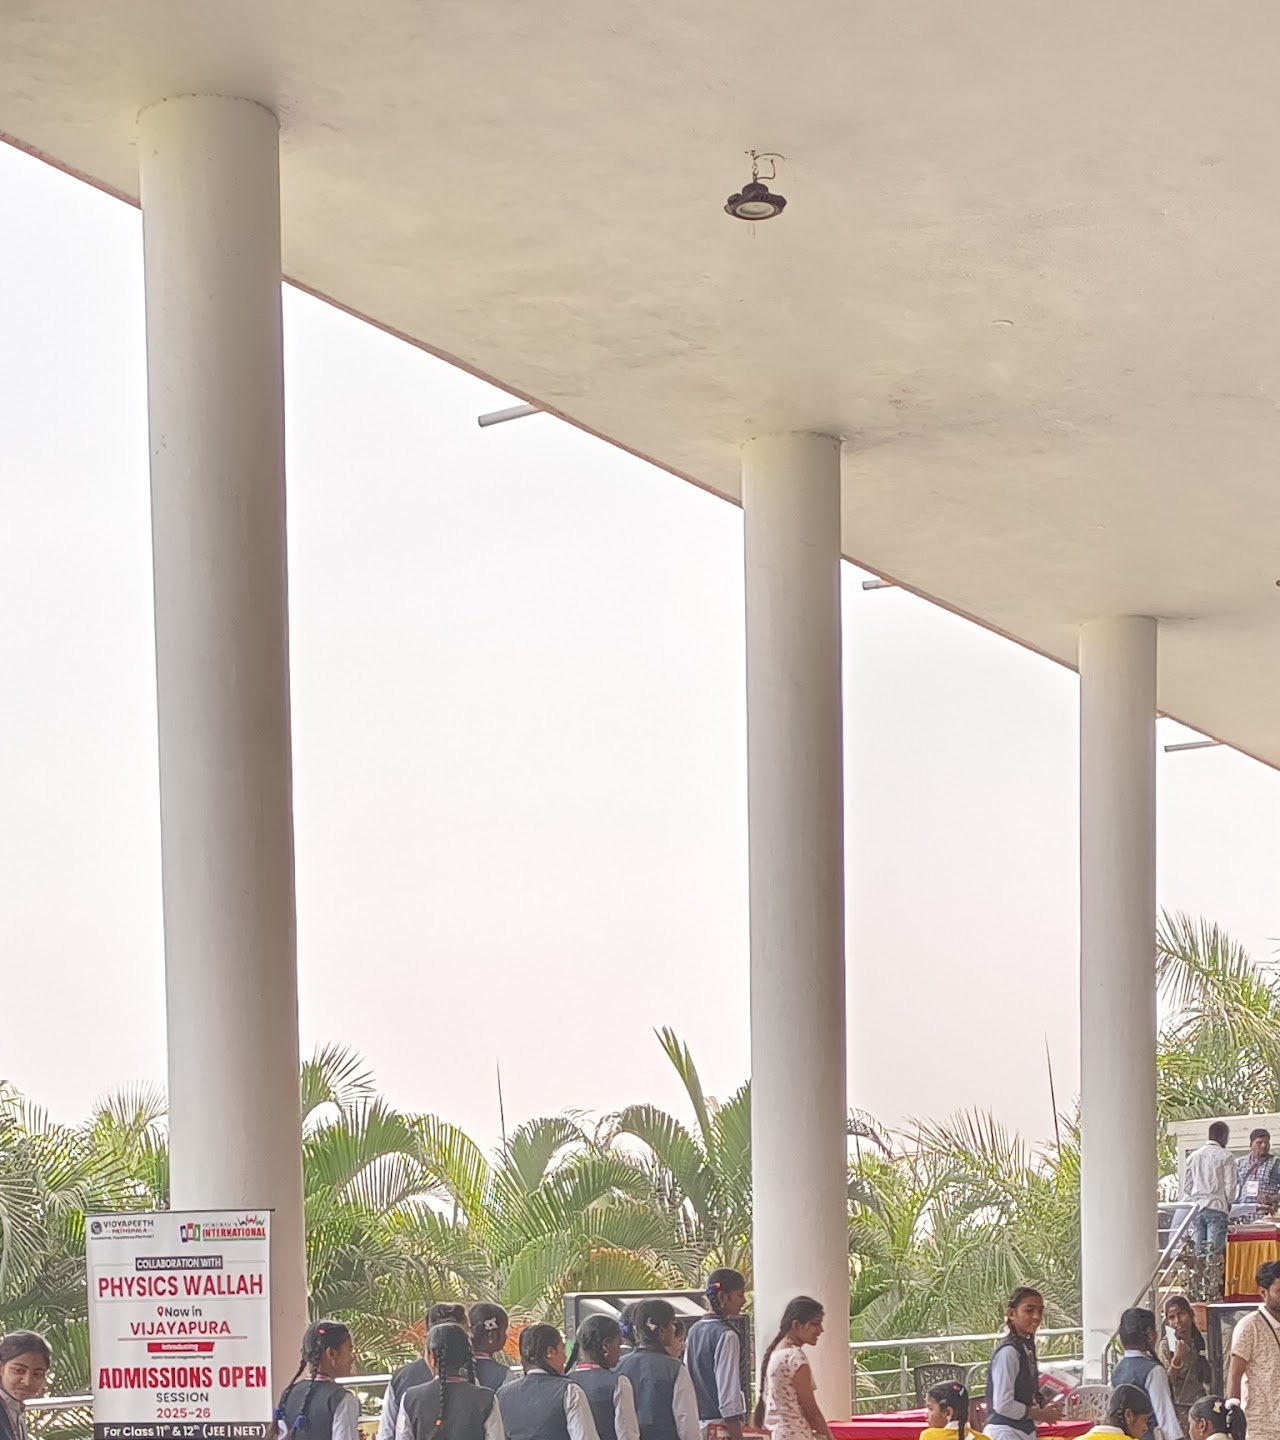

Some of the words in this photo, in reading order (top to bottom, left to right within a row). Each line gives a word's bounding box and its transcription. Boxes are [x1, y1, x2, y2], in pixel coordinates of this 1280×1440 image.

[202, 1227, 266, 1238] INTERNATIONAL
[136, 1259, 199, 1269] COLLABORATION
[200, 1257, 221, 1268] WITH
[98, 1276, 179, 1298] PHYSICS
[183, 1274, 263, 1296] WALLAH
[165, 1307, 189, 1317] Now
[191, 1306, 202, 1316] in
[130, 1321, 231, 1336] VIJAYAPURA
[98, 1366, 213, 1389] ADMISSIONS
[218, 1366, 267, 1388] OPEN
[156, 1392, 209, 1403] SESSION
[156, 1407, 211, 1419] 2025-26
[103, 1427, 121, 1436] For
[123, 1426, 154, 1436] Class
[172, 1427, 181, 1436] &
[203, 1424, 226, 1438] (JEE
[233, 1424, 266, 1437] NEET)
